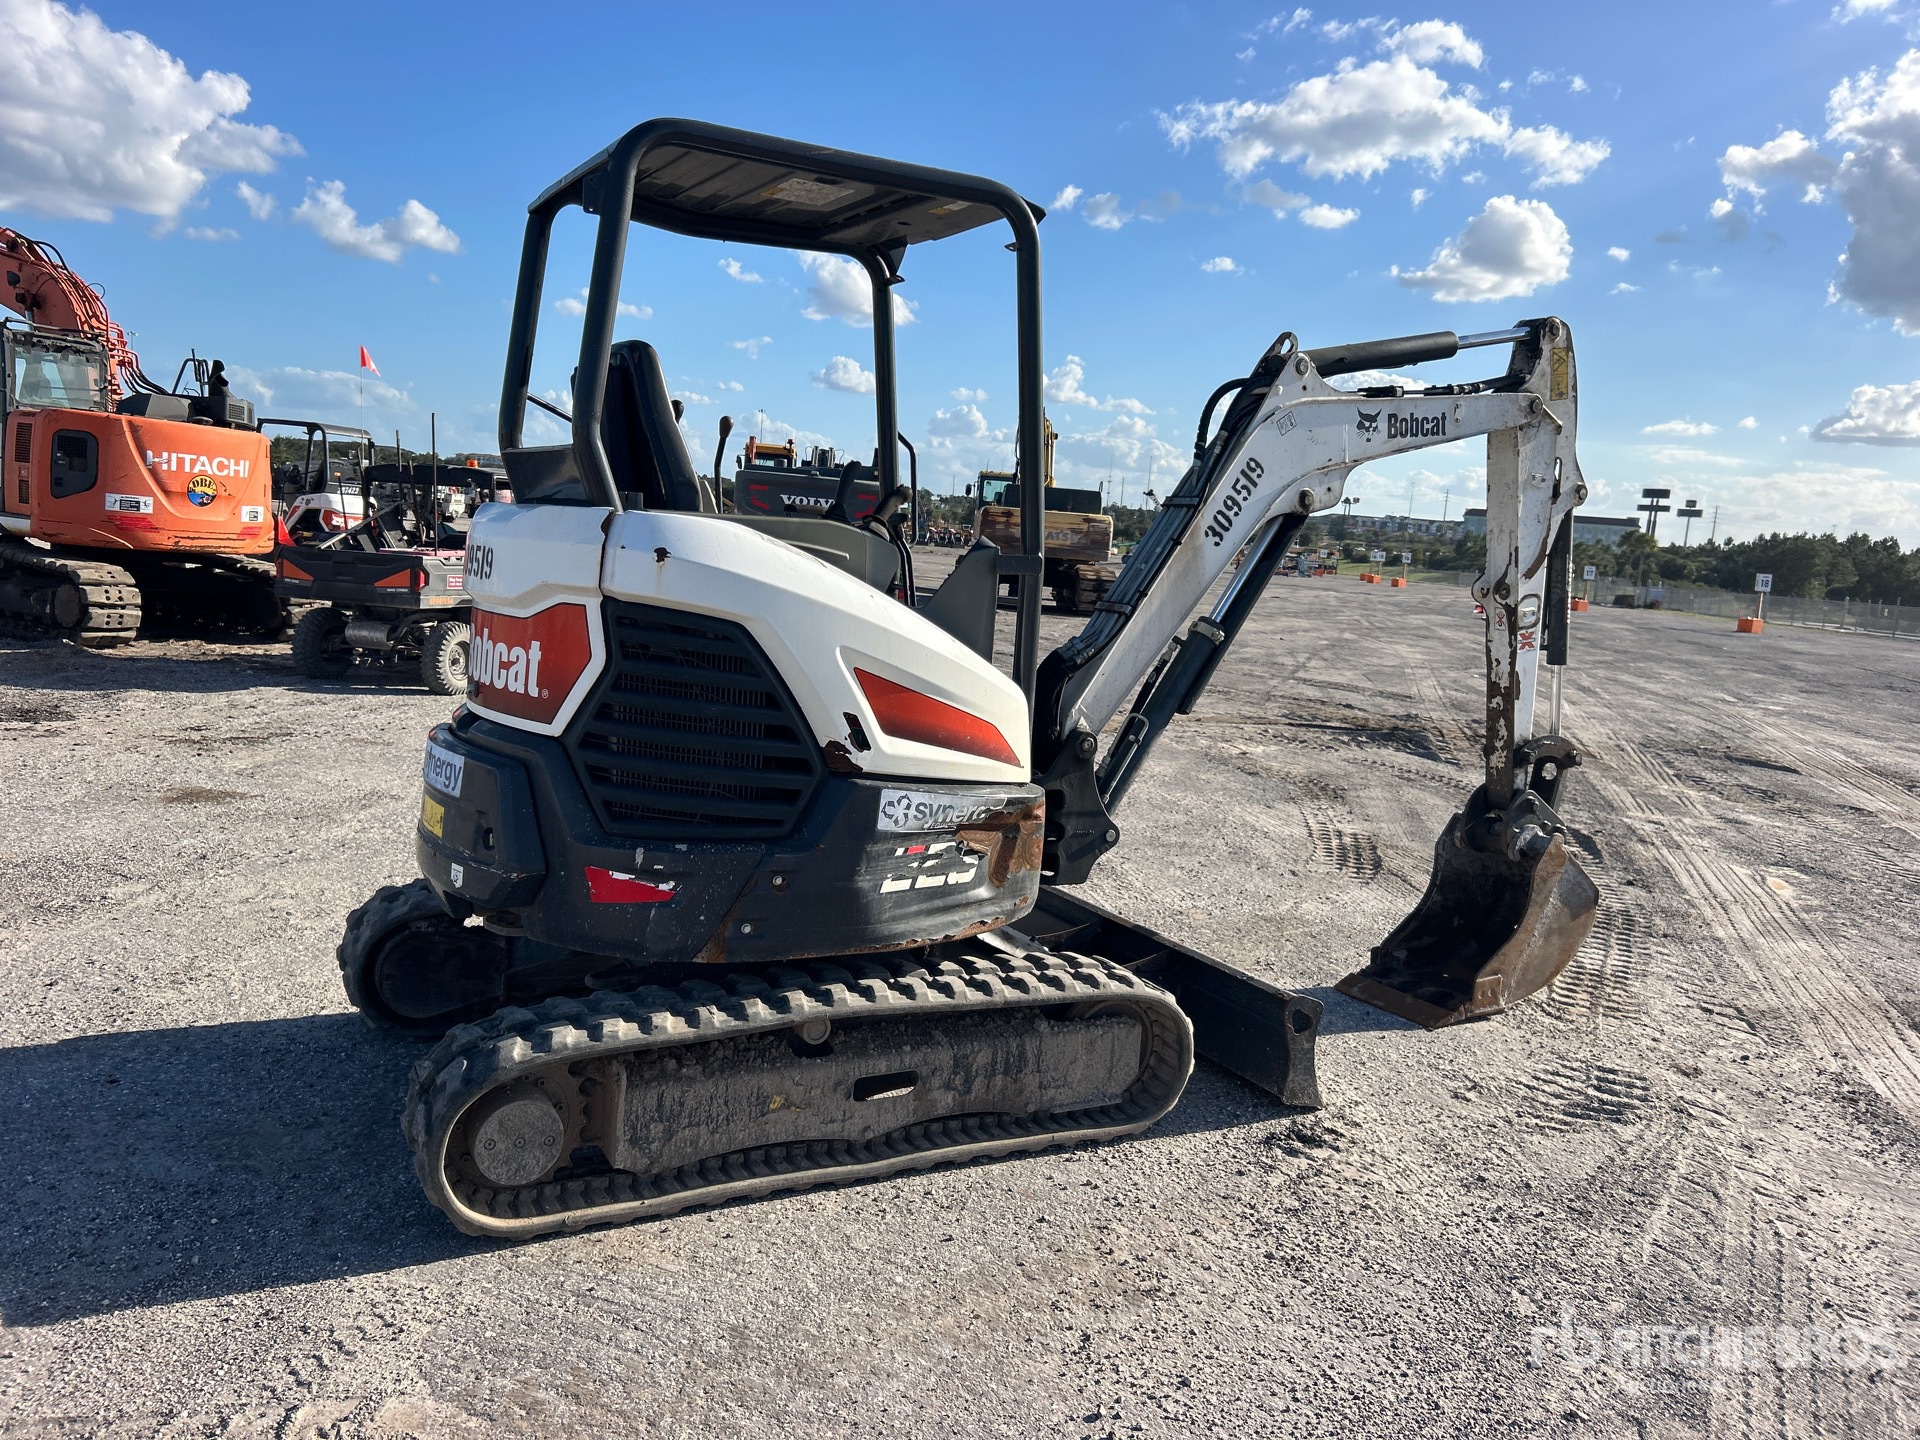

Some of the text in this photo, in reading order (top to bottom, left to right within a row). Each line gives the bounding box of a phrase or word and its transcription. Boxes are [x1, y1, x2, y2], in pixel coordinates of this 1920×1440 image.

[1387, 412, 1447, 439] Bobcat
[146, 450, 250, 478] HITACHI
[191, 477, 215, 490] DBE
[779, 494, 836, 508] VOLV
[1204, 457, 1265, 547] 309519
[465, 544, 494, 580] 9519
[1760, 579, 1770, 588] 18
